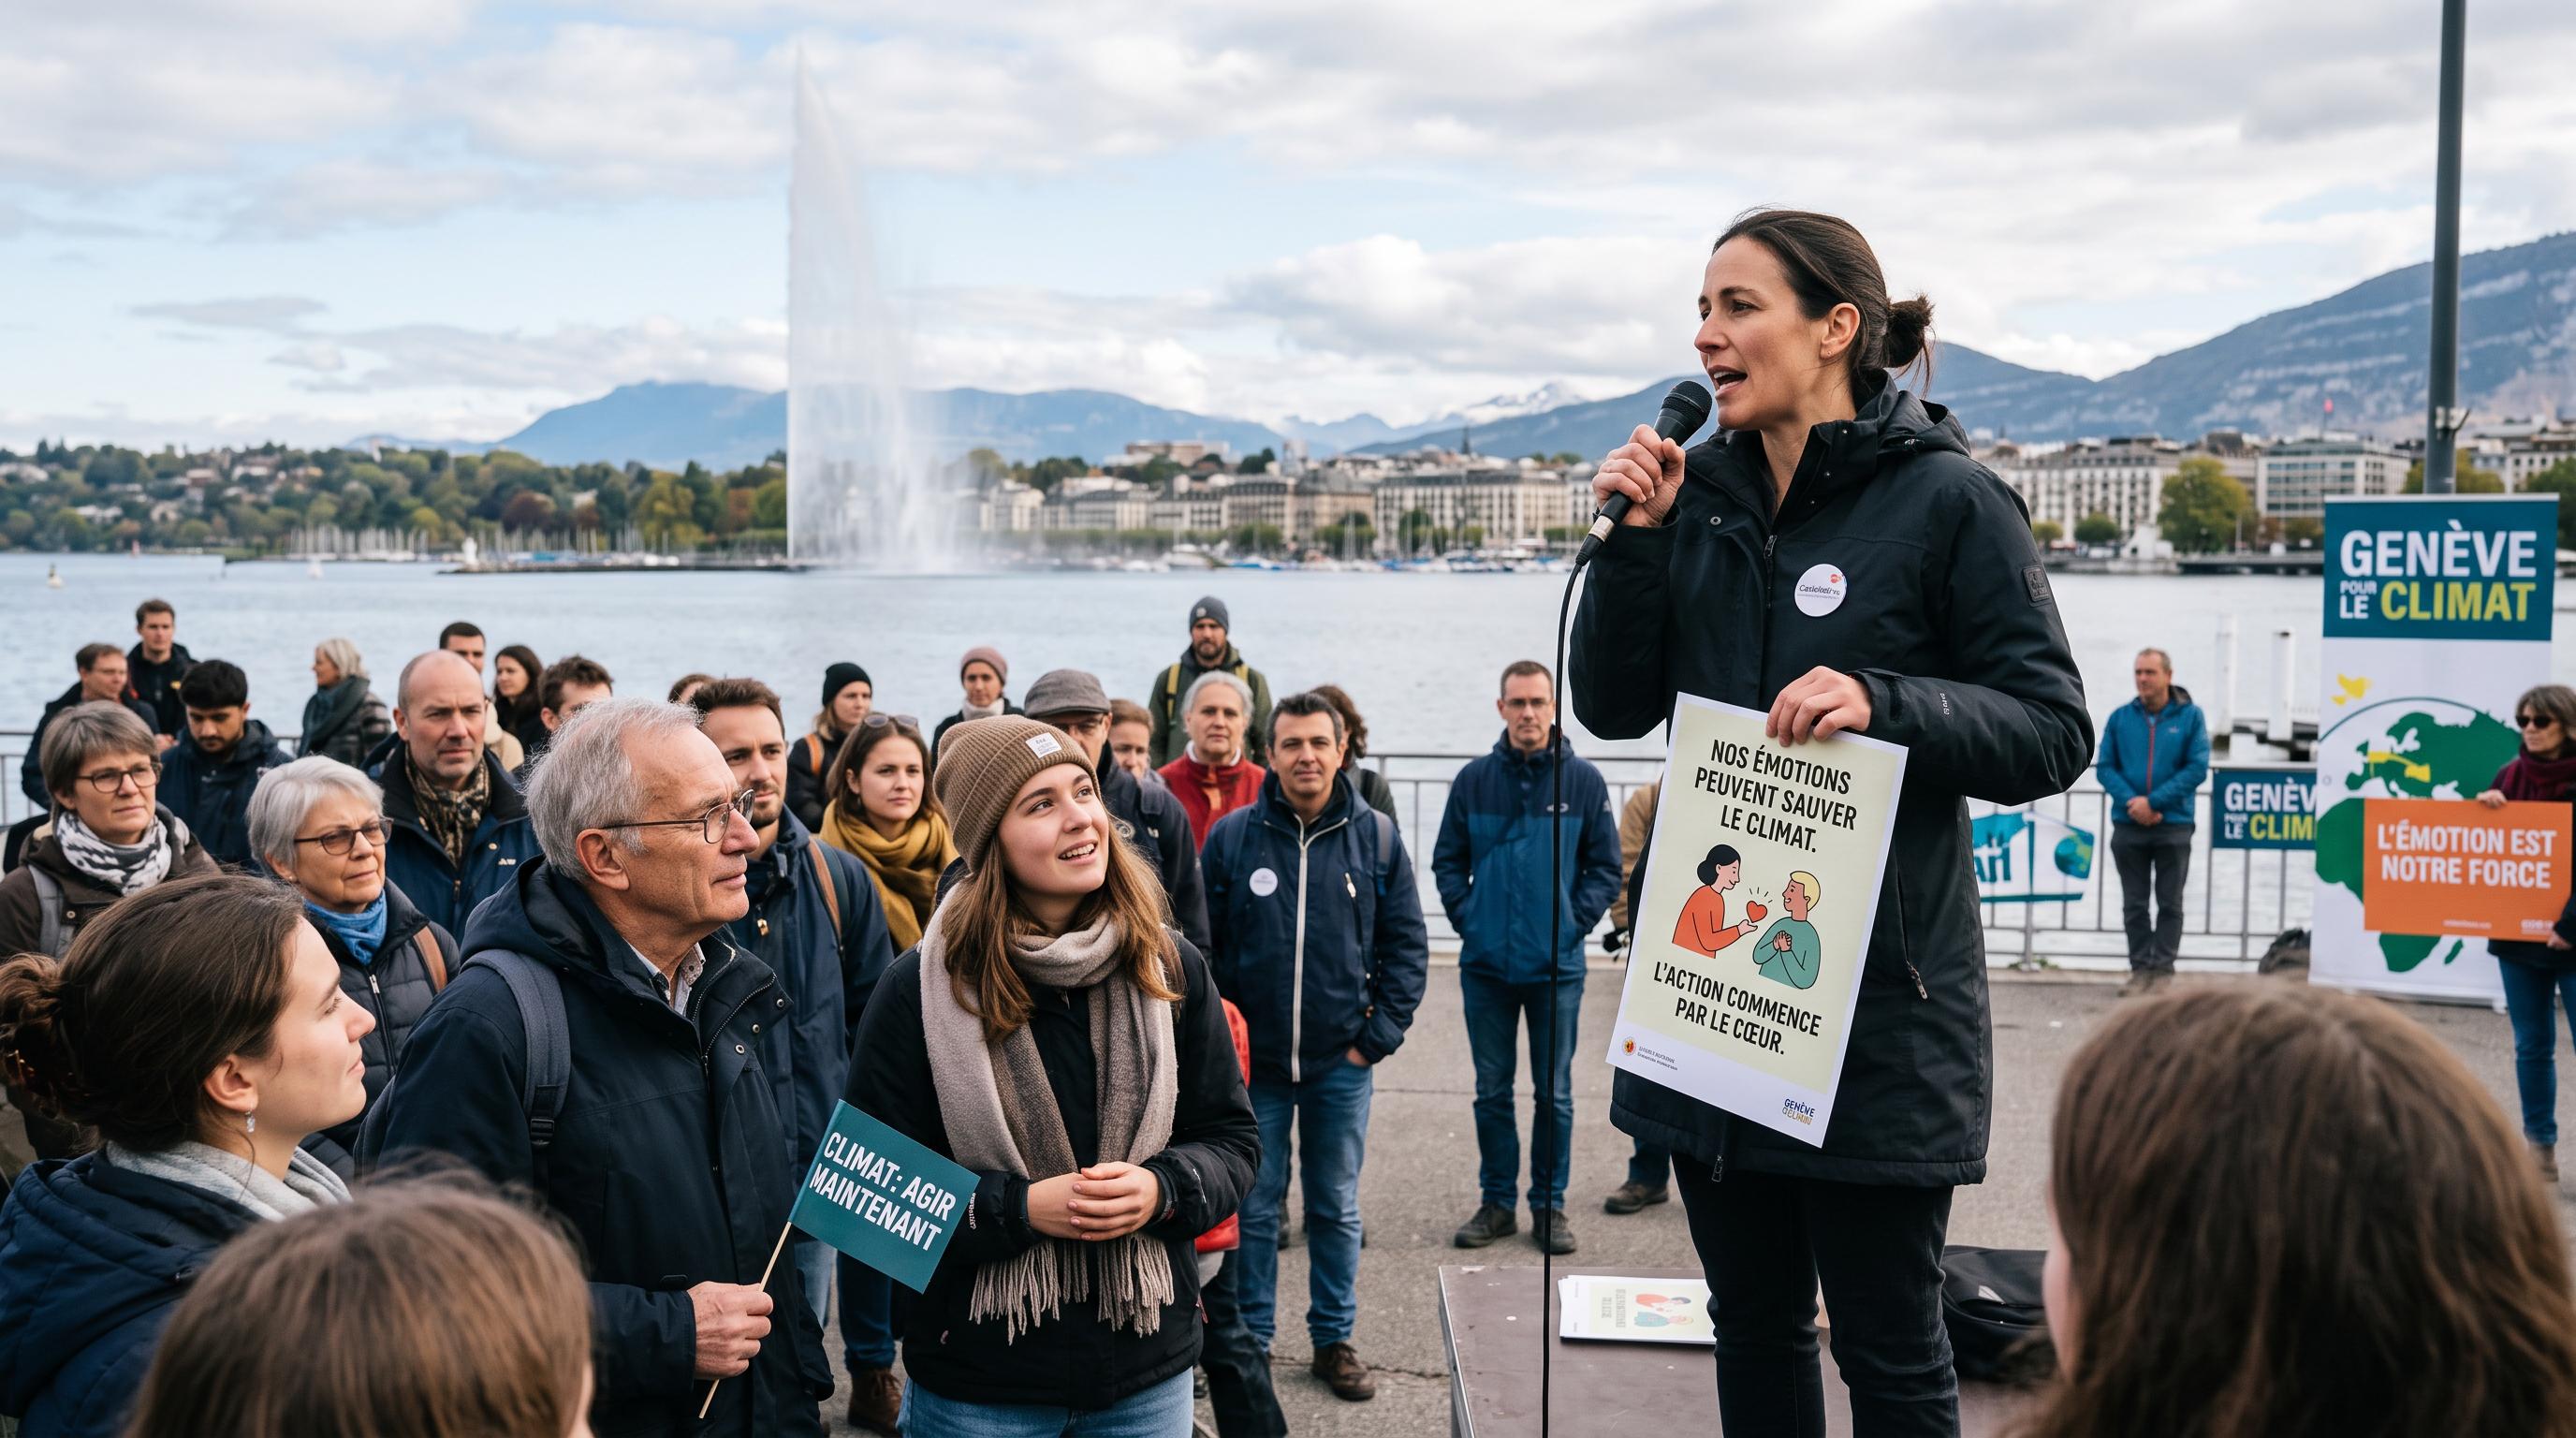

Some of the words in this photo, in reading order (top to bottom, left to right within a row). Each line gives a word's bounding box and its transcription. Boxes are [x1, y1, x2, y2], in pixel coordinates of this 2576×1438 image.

[2340, 519, 2537, 578] GENÈVE
[2340, 580, 2377, 595] POUR
[2340, 595, 2369, 619] LE
[2380, 580, 2537, 622] CLIMAT
[1711, 739, 1749, 769] NOS
[1753, 744, 1852, 795] ÉMOTIONS
[1694, 767, 1779, 808] PEUVENT
[1781, 789, 1857, 830] SAUVER
[2224, 776, 2317, 813] GENÈV
[1720, 804, 1744, 831] LE
[1746, 812, 1817, 853] CLIMAT.
[2224, 823, 2244, 840] LE
[2249, 813, 2313, 841] CLIM
[2377, 819, 2505, 855] L'ÉMOTION
[2510, 829, 2557, 857] EST
[2381, 854, 2463, 885] NOTRE
[2468, 858, 2552, 889] FORCE
[1653, 961, 1724, 1003] L'ACTION
[1727, 986, 1822, 1037] COMMENCE
[1675, 997, 1707, 1026] PAR
[1710, 1009, 1731, 1034] LE
[1733, 1018, 1784, 1055] CŒUR.
[1784, 1098, 1815, 1118] GENÈVE
[823, 1131, 902, 1194] CLIMAT:
[900, 1176, 957, 1222] AGIR
[809, 1163, 943, 1252] MAINTENANT
